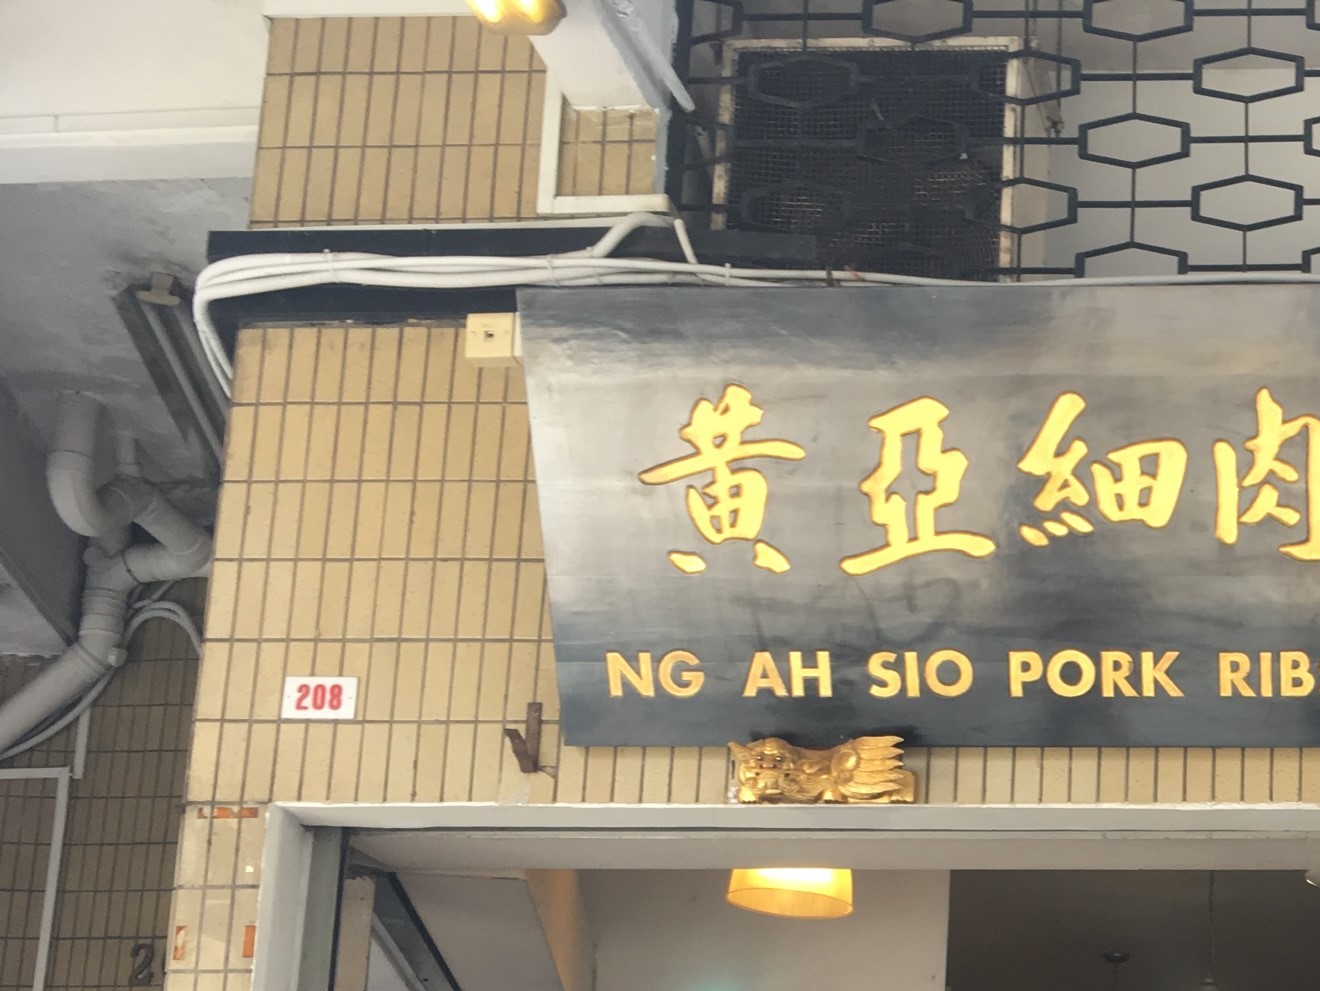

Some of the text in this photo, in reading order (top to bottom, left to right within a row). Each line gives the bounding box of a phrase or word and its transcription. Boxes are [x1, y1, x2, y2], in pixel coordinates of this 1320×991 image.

[605, 650, 706, 699] NG
[743, 650, 833, 699] AH
[868, 650, 973, 699] SIO
[1009, 649, 1184, 699] PORK
[295, 684, 343, 710] 208
